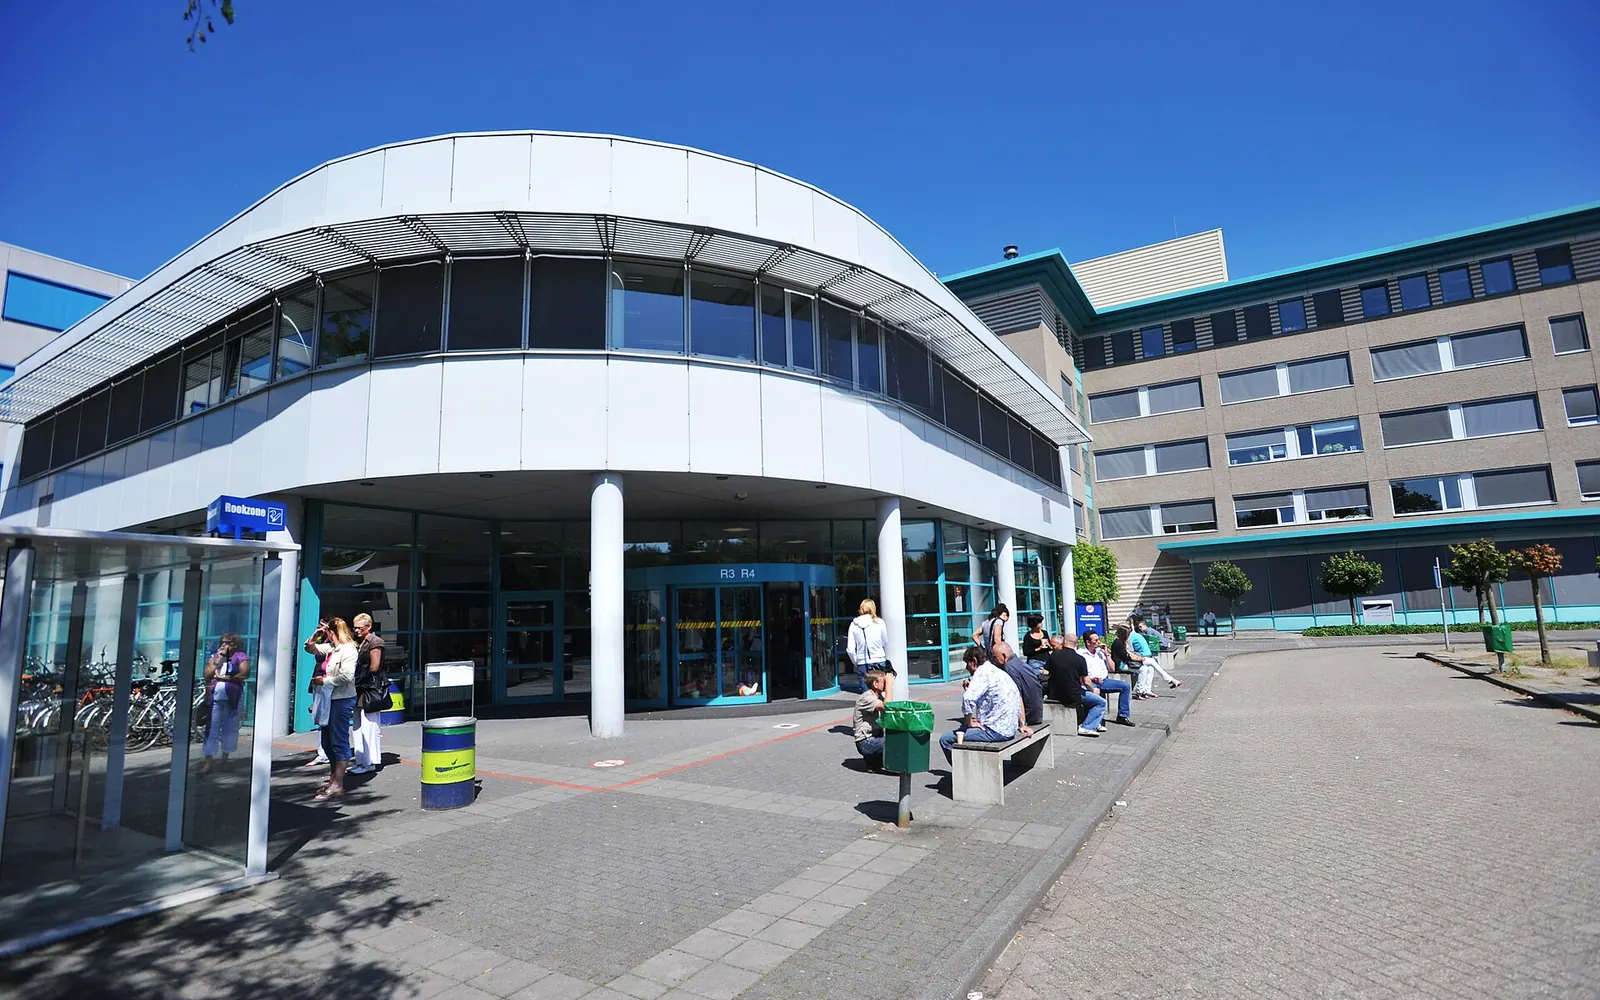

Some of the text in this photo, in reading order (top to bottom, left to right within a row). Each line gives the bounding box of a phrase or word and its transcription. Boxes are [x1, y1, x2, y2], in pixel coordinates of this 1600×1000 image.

[224, 502, 266, 517] Rookzone
[720, 568, 755, 579] R3 R4
